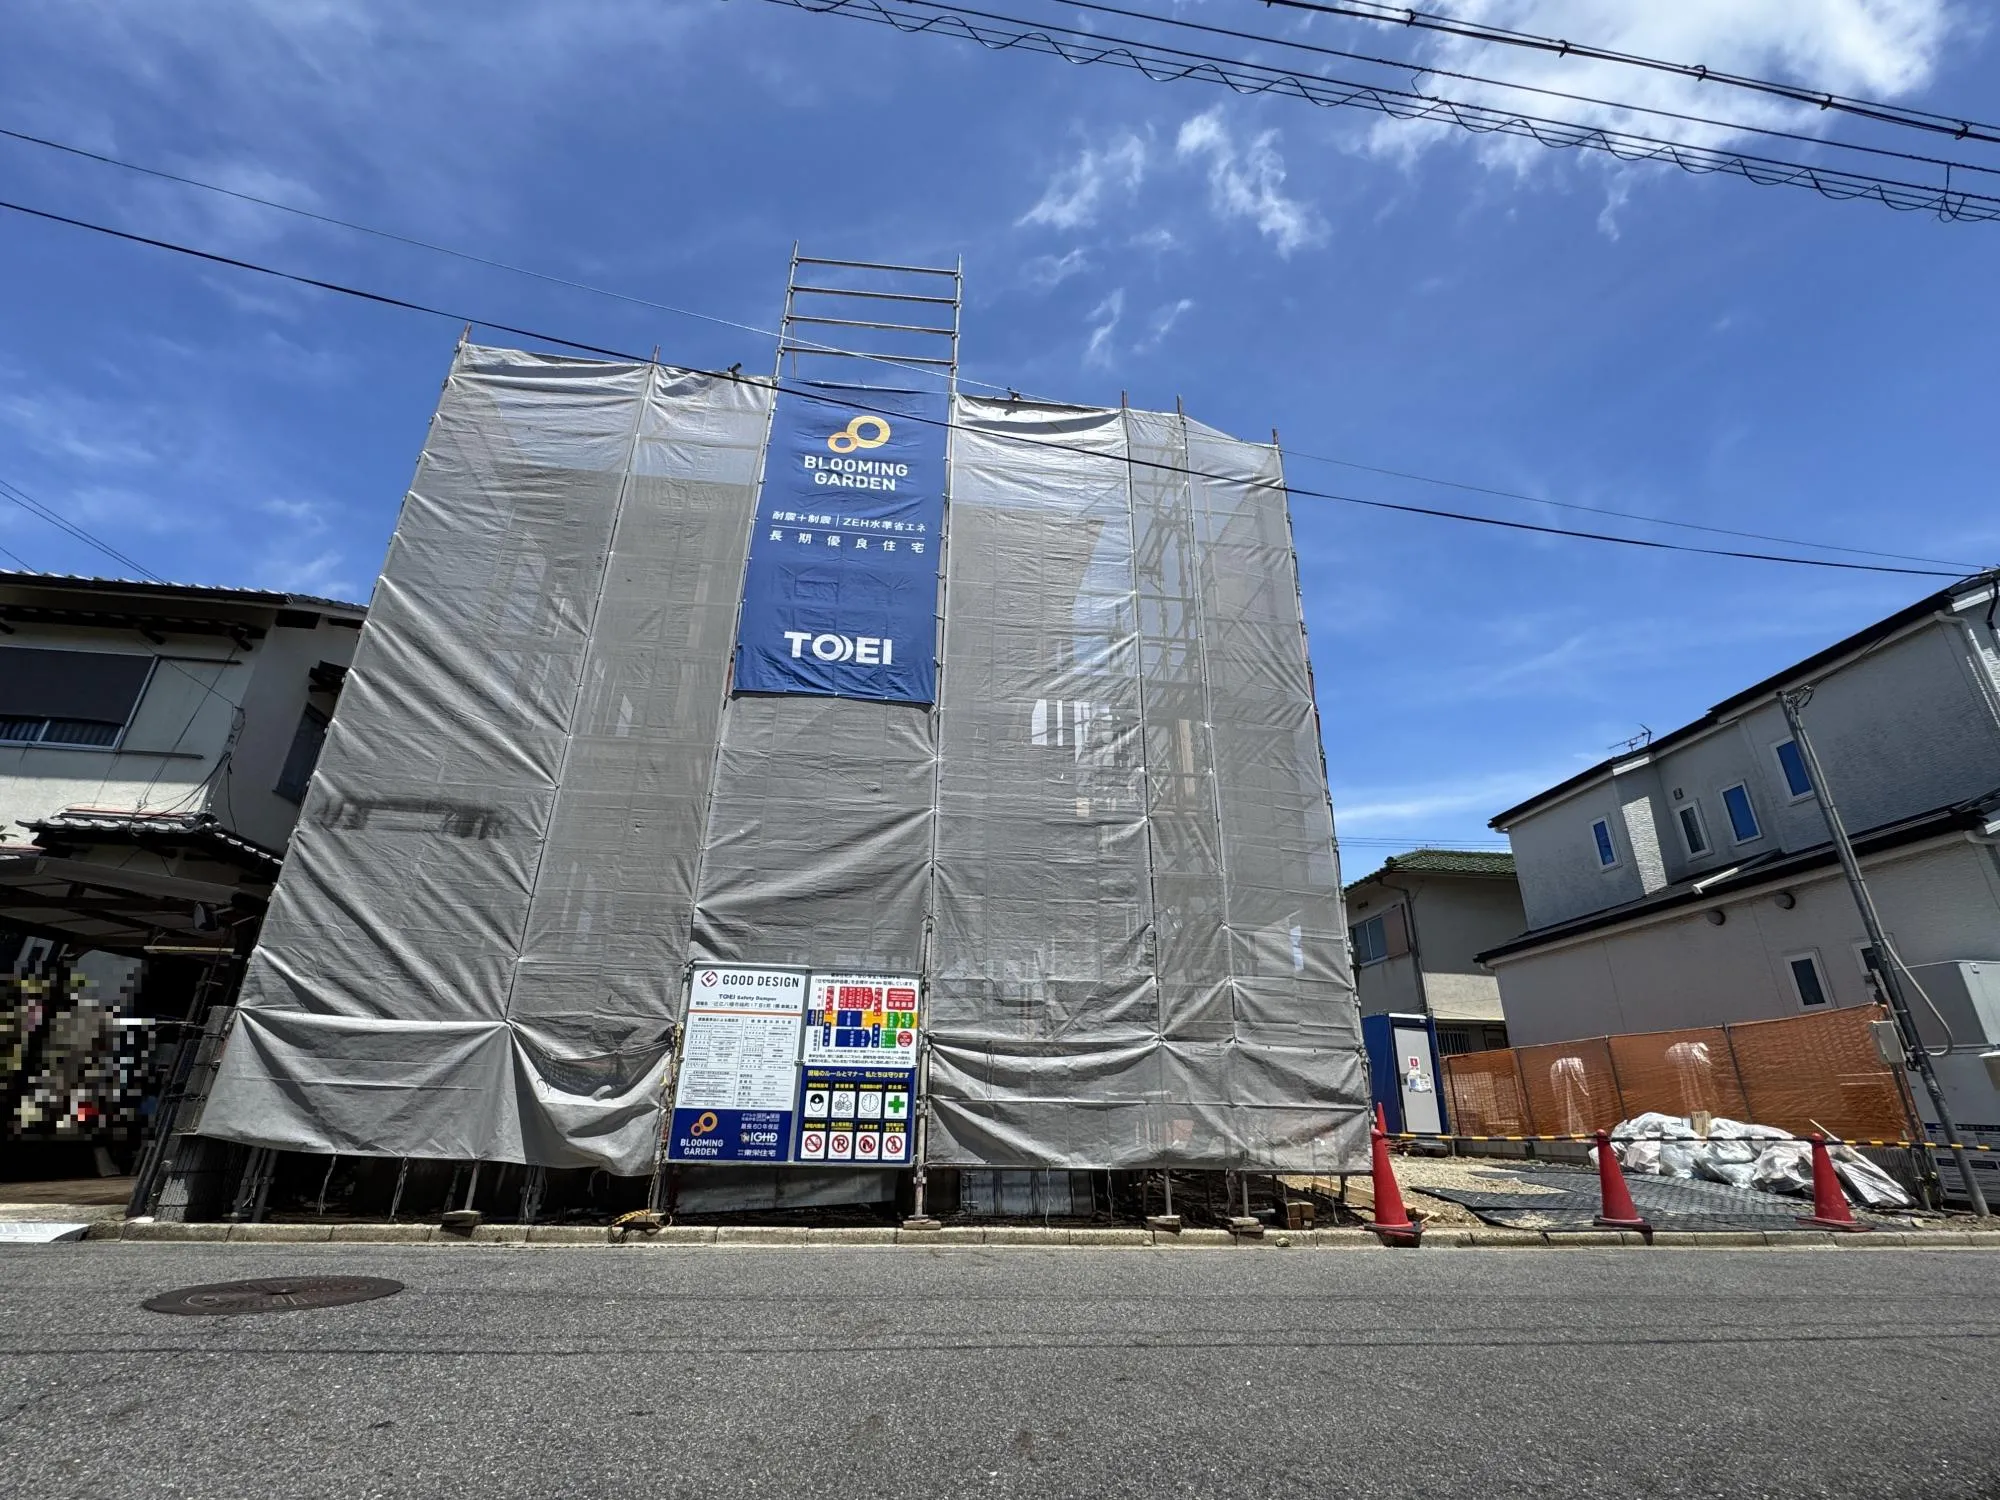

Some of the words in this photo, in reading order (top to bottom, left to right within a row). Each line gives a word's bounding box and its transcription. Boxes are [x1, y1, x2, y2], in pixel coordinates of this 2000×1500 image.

[804, 455, 908, 477] BLOOMING
[814, 472, 896, 491] GARDEN
[769, 530, 925, 553] 長期優良住宅
[784, 631, 893, 665] TOEI
[722, 974, 754, 985] GOOD
[757, 976, 800, 988] DESIGN
[680, 1138, 724, 1148] BLOOMING
[683, 1147, 718, 1156] GARDEN
